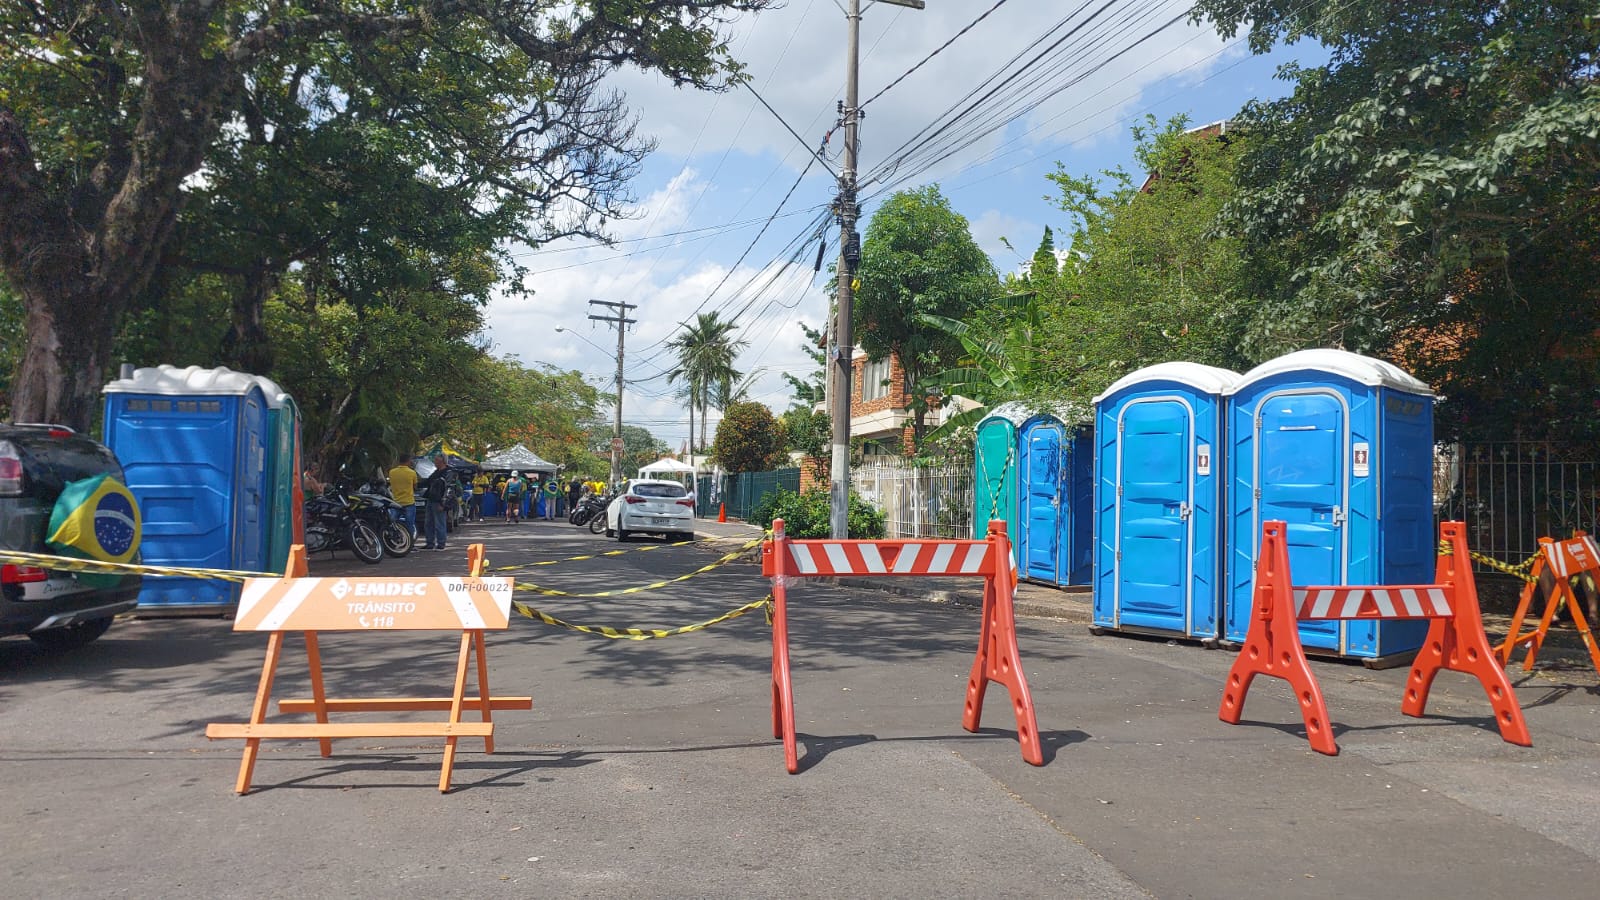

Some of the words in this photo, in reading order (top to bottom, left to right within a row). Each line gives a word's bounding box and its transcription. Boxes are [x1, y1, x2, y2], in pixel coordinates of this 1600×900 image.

[354, 582, 428, 596] EMDEC
[347, 600, 416, 614] TRÂNSITO
[373, 616, 394, 627] 118
